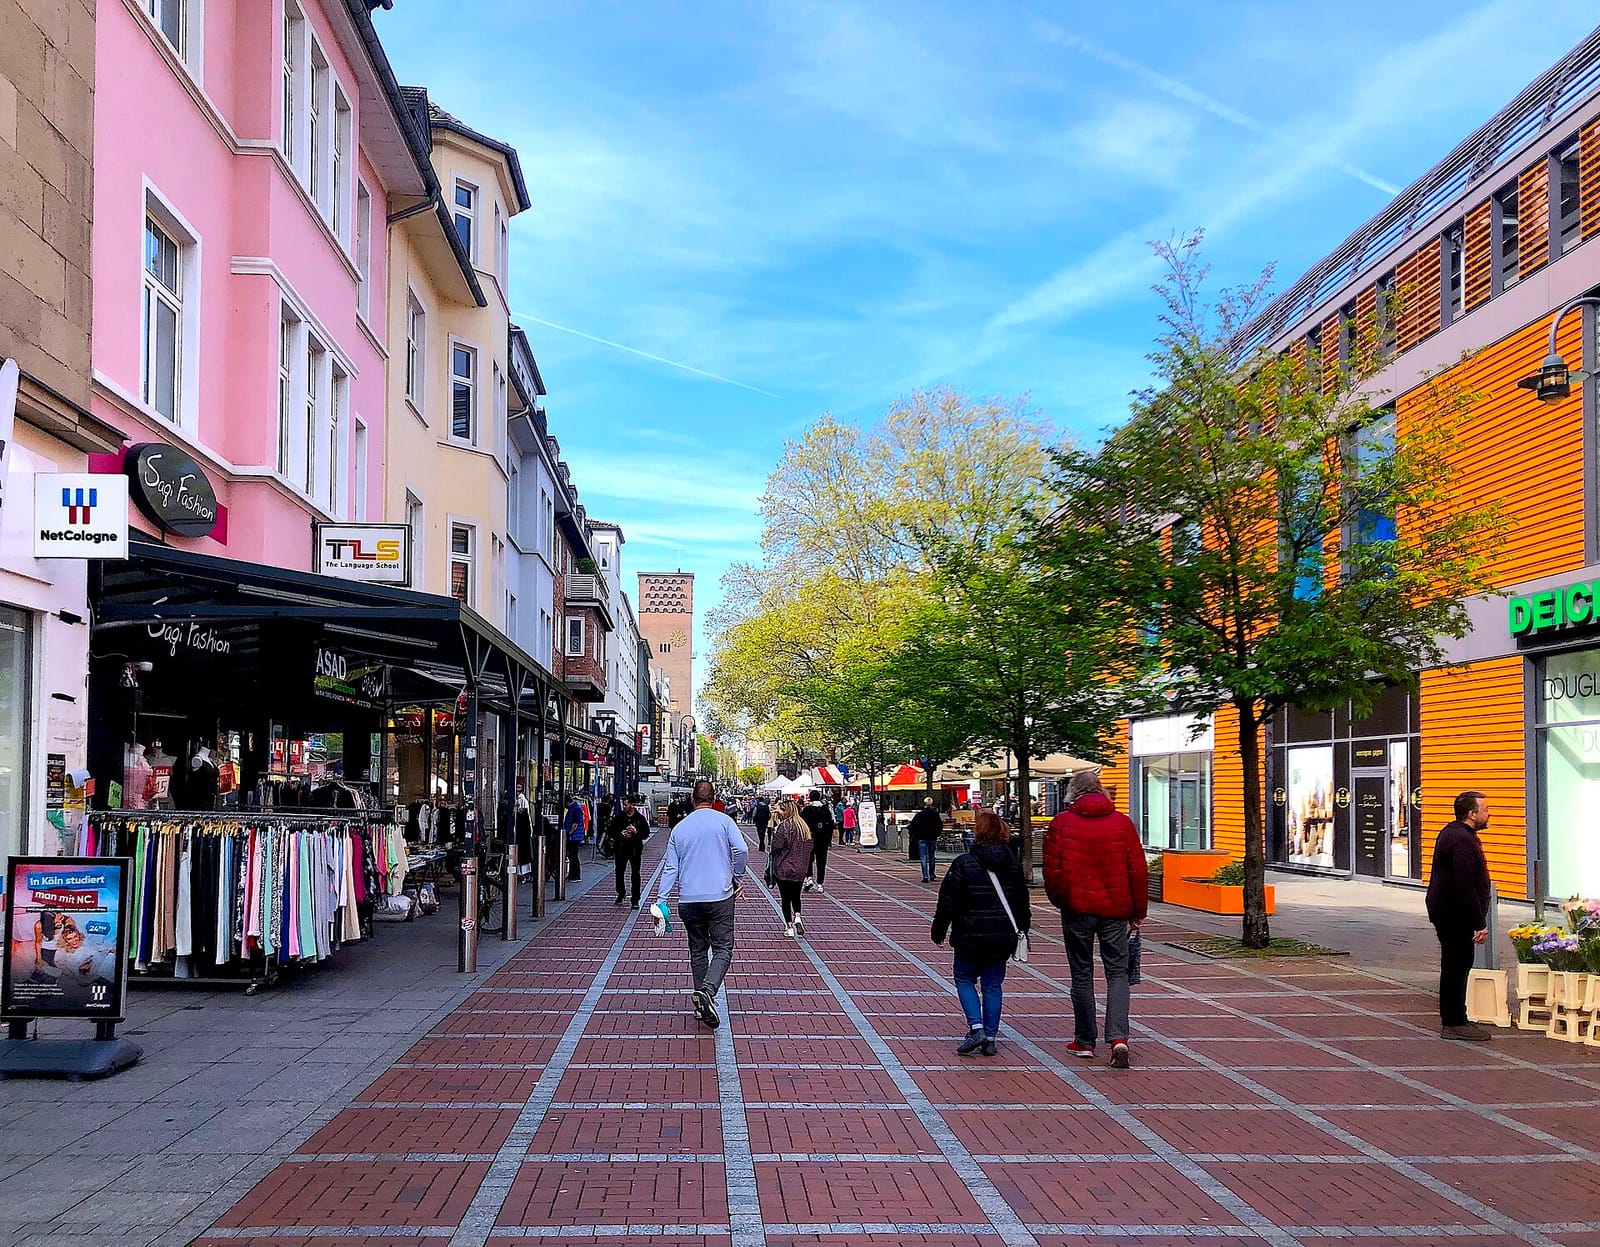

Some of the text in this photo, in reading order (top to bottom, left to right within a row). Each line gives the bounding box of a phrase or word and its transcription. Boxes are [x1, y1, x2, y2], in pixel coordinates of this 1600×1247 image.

[143, 453, 215, 522] Sagi Fashion
[40, 529, 118, 544] NetCologne
[325, 538, 401, 561] TLS
[325, 561, 400, 570] The Language School
[315, 647, 348, 681] ASAD
[42, 875, 64, 885] Köln
[65, 874, 106, 885] studiert
[35, 892, 95, 905] man mit NC.
